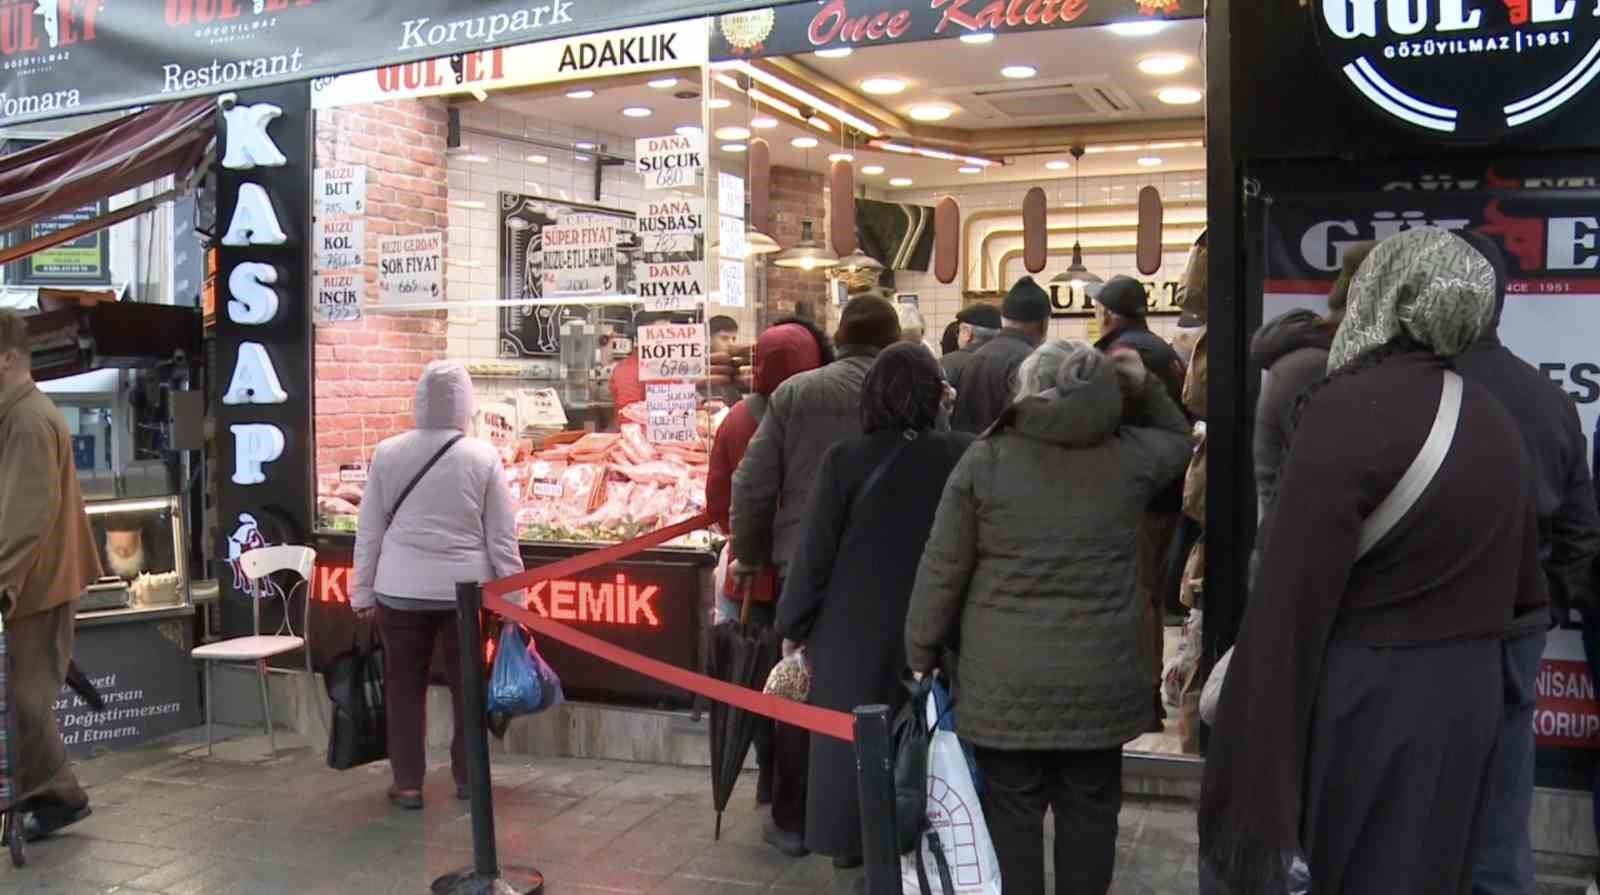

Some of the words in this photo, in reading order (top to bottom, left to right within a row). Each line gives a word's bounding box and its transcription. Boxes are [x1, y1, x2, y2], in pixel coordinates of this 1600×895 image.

[399, 0, 573, 50] Korupark
[558, 33, 678, 73] ADAKLIK
[1384, 37, 1510, 59] GÖZÜYILMAZ
[1525, 31, 1571, 47] 1951
[161, 48, 304, 93] Restorant
[649, 137, 690, 152] DANA
[639, 152, 701, 172] SUCUK
[325, 182, 352, 196] BUT
[649, 202, 690, 216] DANA
[324, 236, 353, 250] KOL
[649, 264, 691, 278] DANA
[639, 280, 702, 297] KIYMA
[646, 327, 696, 341] KASAP
